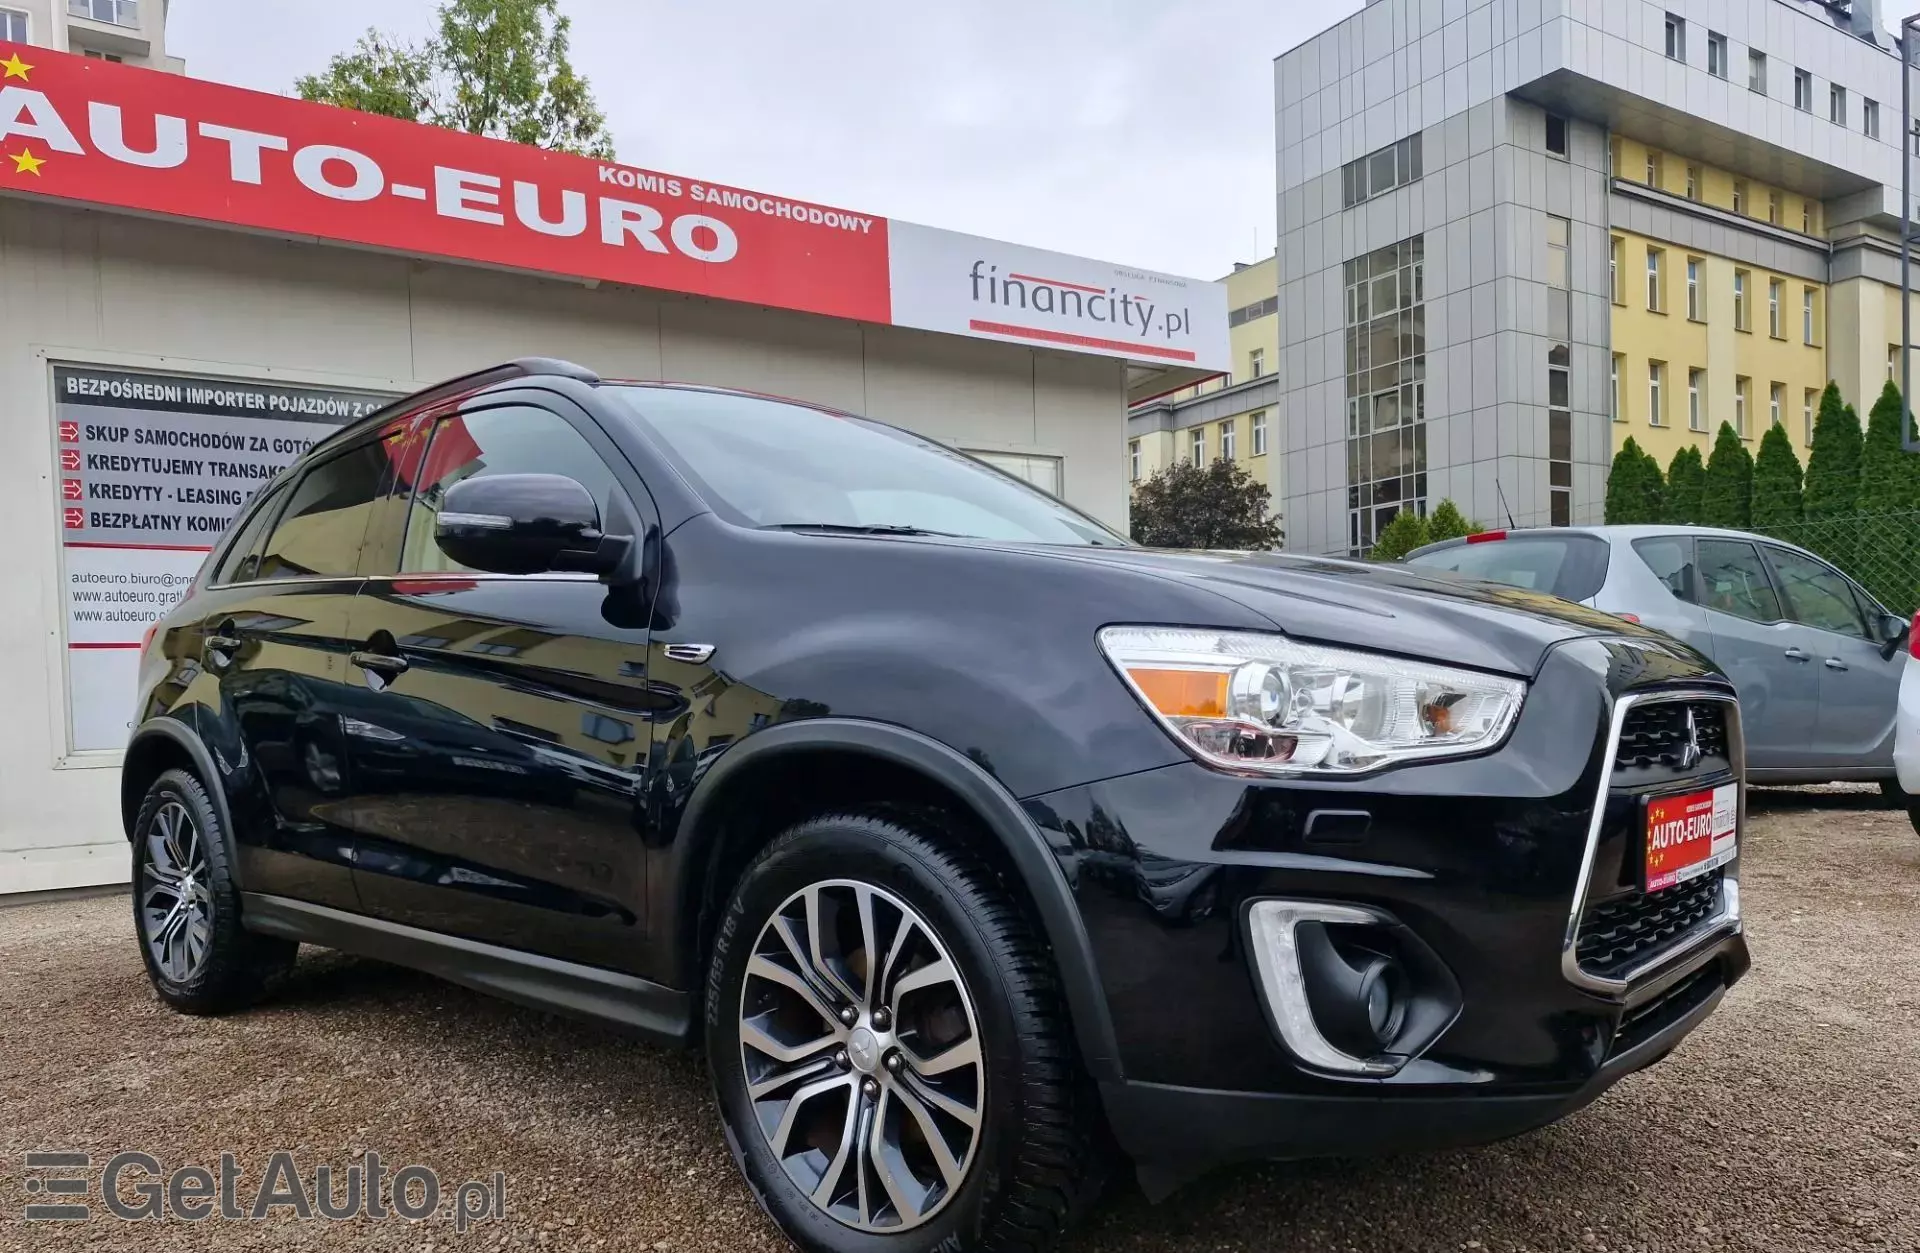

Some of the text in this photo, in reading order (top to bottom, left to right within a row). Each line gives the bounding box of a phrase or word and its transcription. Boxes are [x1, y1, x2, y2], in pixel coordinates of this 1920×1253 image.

[0, 86, 738, 263] AUTO-EURO
[598, 166, 873, 234] KOMIS SAMOCHODOWY
[969, 260, 1190, 338] financity.pl
[66, 376, 182, 402] BEZPOŚREDNI
[186, 387, 265, 410] IMPORTER
[269, 393, 350, 416] POJAZDÓW
[353, 402, 363, 418] Z
[86, 424, 315, 454] SKUP SAMOCHODÓW ZA GOTÓ
[87, 454, 204, 475] KREDYTUJEMY
[88, 483, 163, 502] KREDYTY
[177, 488, 242, 505] LEASING
[90, 511, 183, 532] BEZPŁATNY
[1651, 812, 1712, 850] AUTO-EURO
